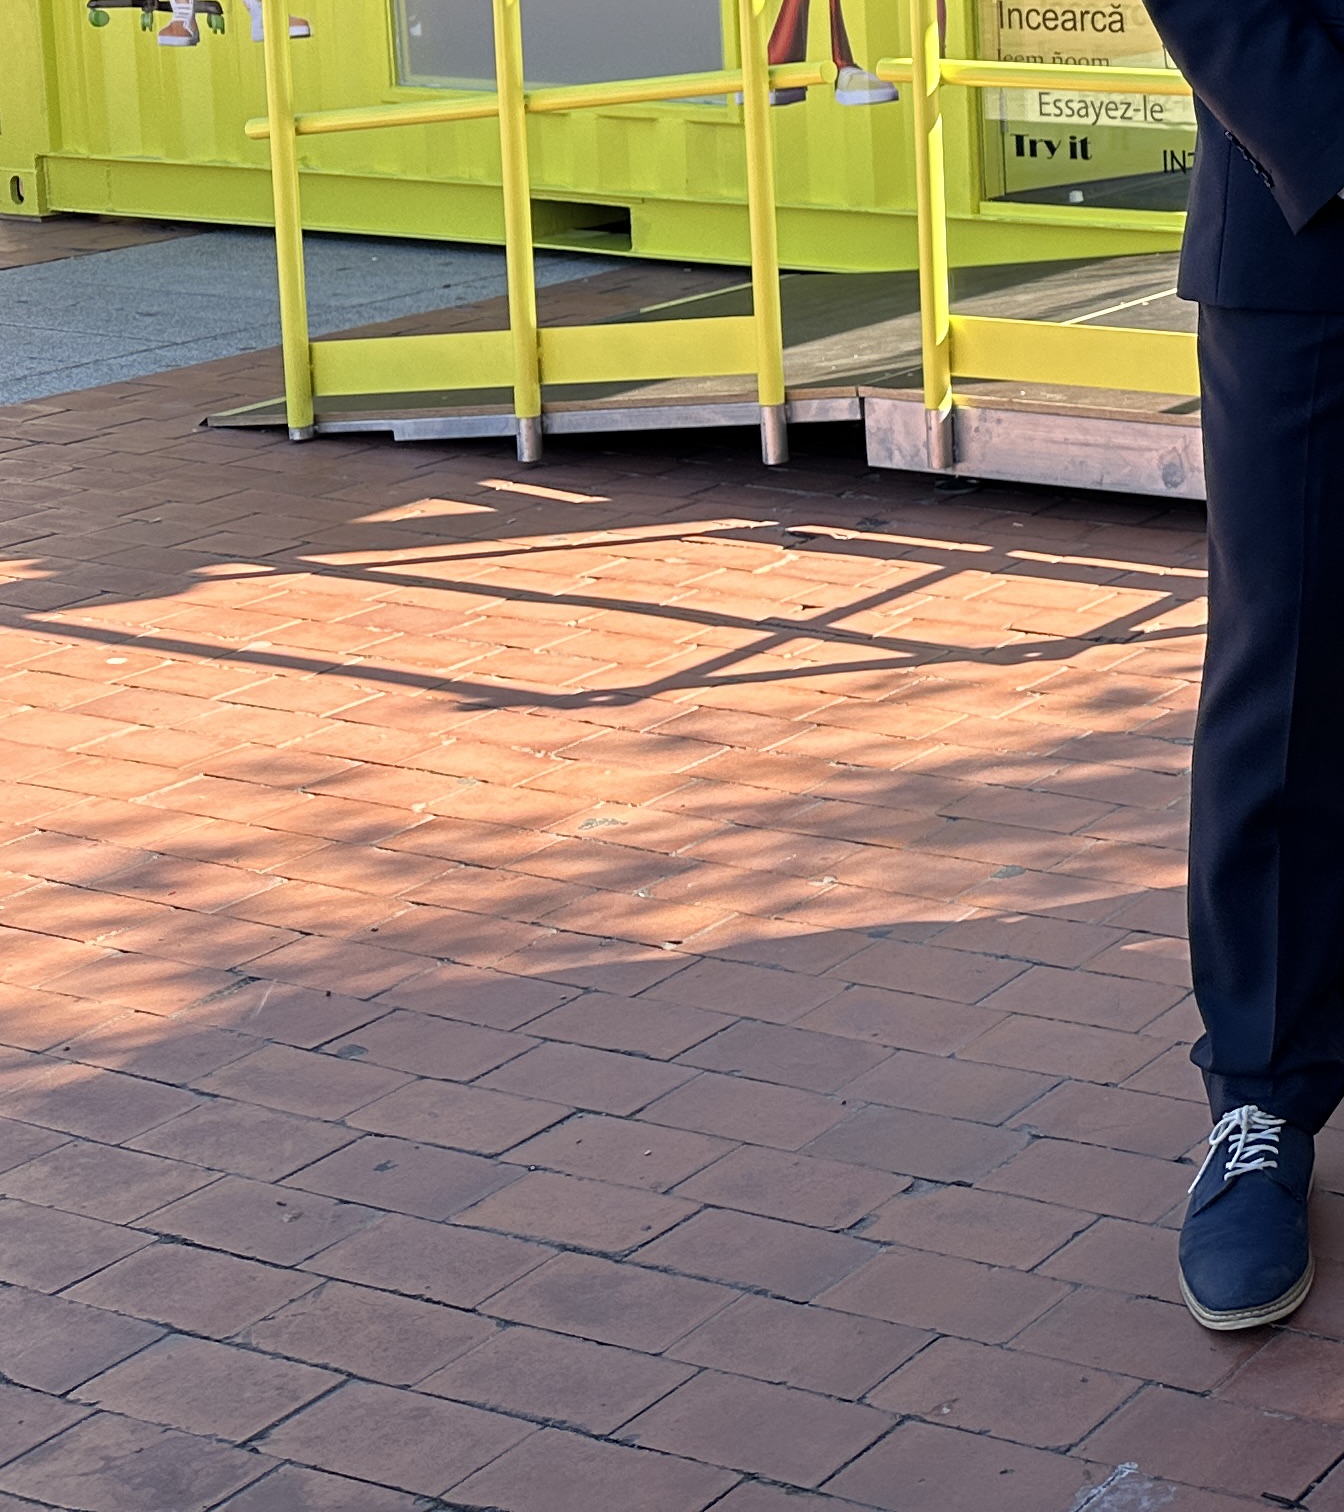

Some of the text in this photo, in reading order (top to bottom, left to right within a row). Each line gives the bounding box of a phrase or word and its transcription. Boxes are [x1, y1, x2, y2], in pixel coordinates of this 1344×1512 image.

[1039, 90, 1165, 125] Essayez-le
[1010, 133, 1093, 161] Try it
